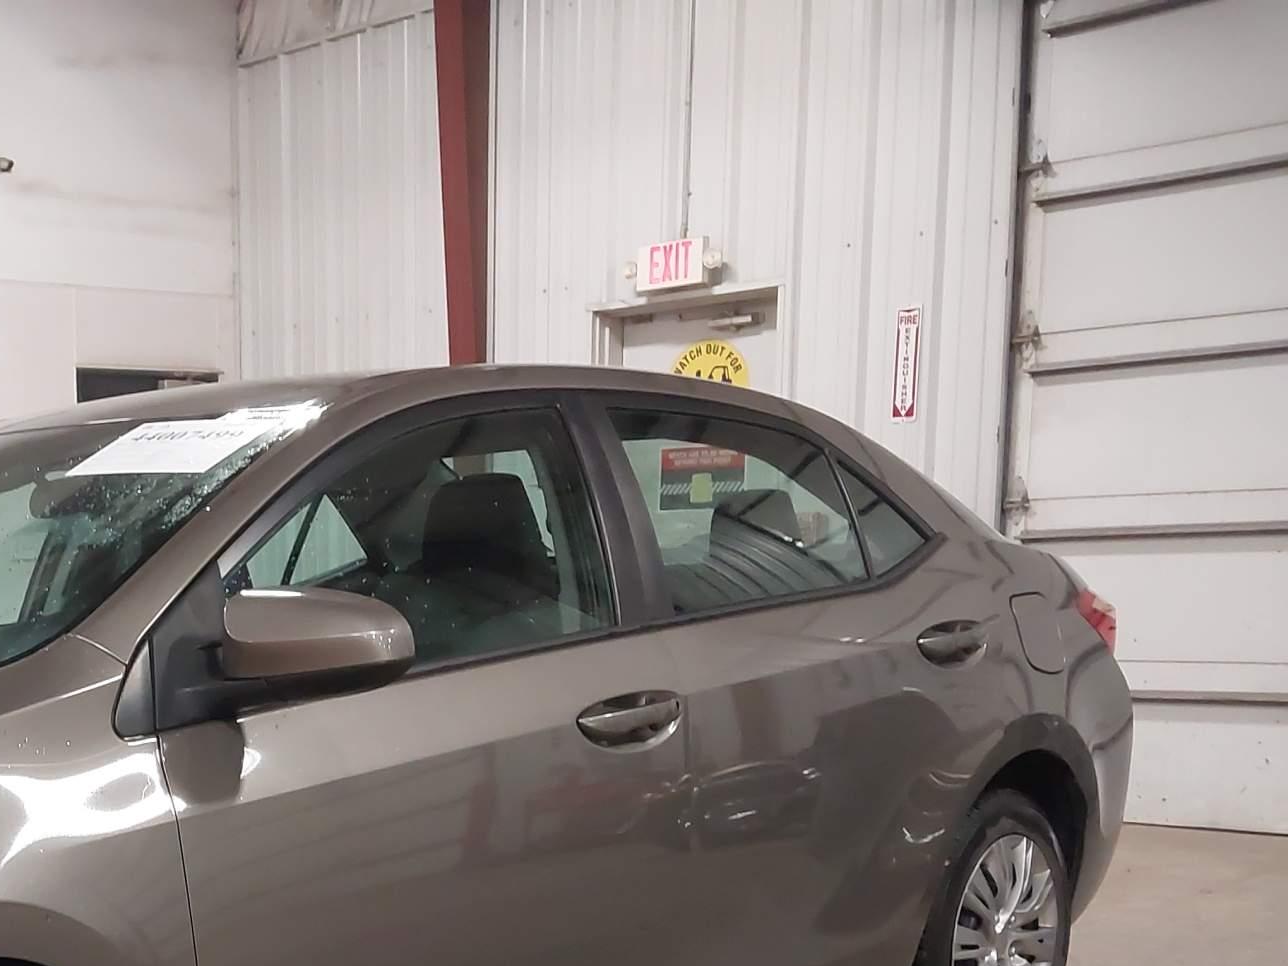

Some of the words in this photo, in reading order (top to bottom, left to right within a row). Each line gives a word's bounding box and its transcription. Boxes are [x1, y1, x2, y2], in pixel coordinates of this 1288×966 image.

[649, 240, 692, 284] EXIT
[899, 314, 918, 325] FIRE
[705, 343, 726, 357] OUT
[725, 351, 743, 374] FOR
[900, 327, 911, 411] EXTINGUISHER
